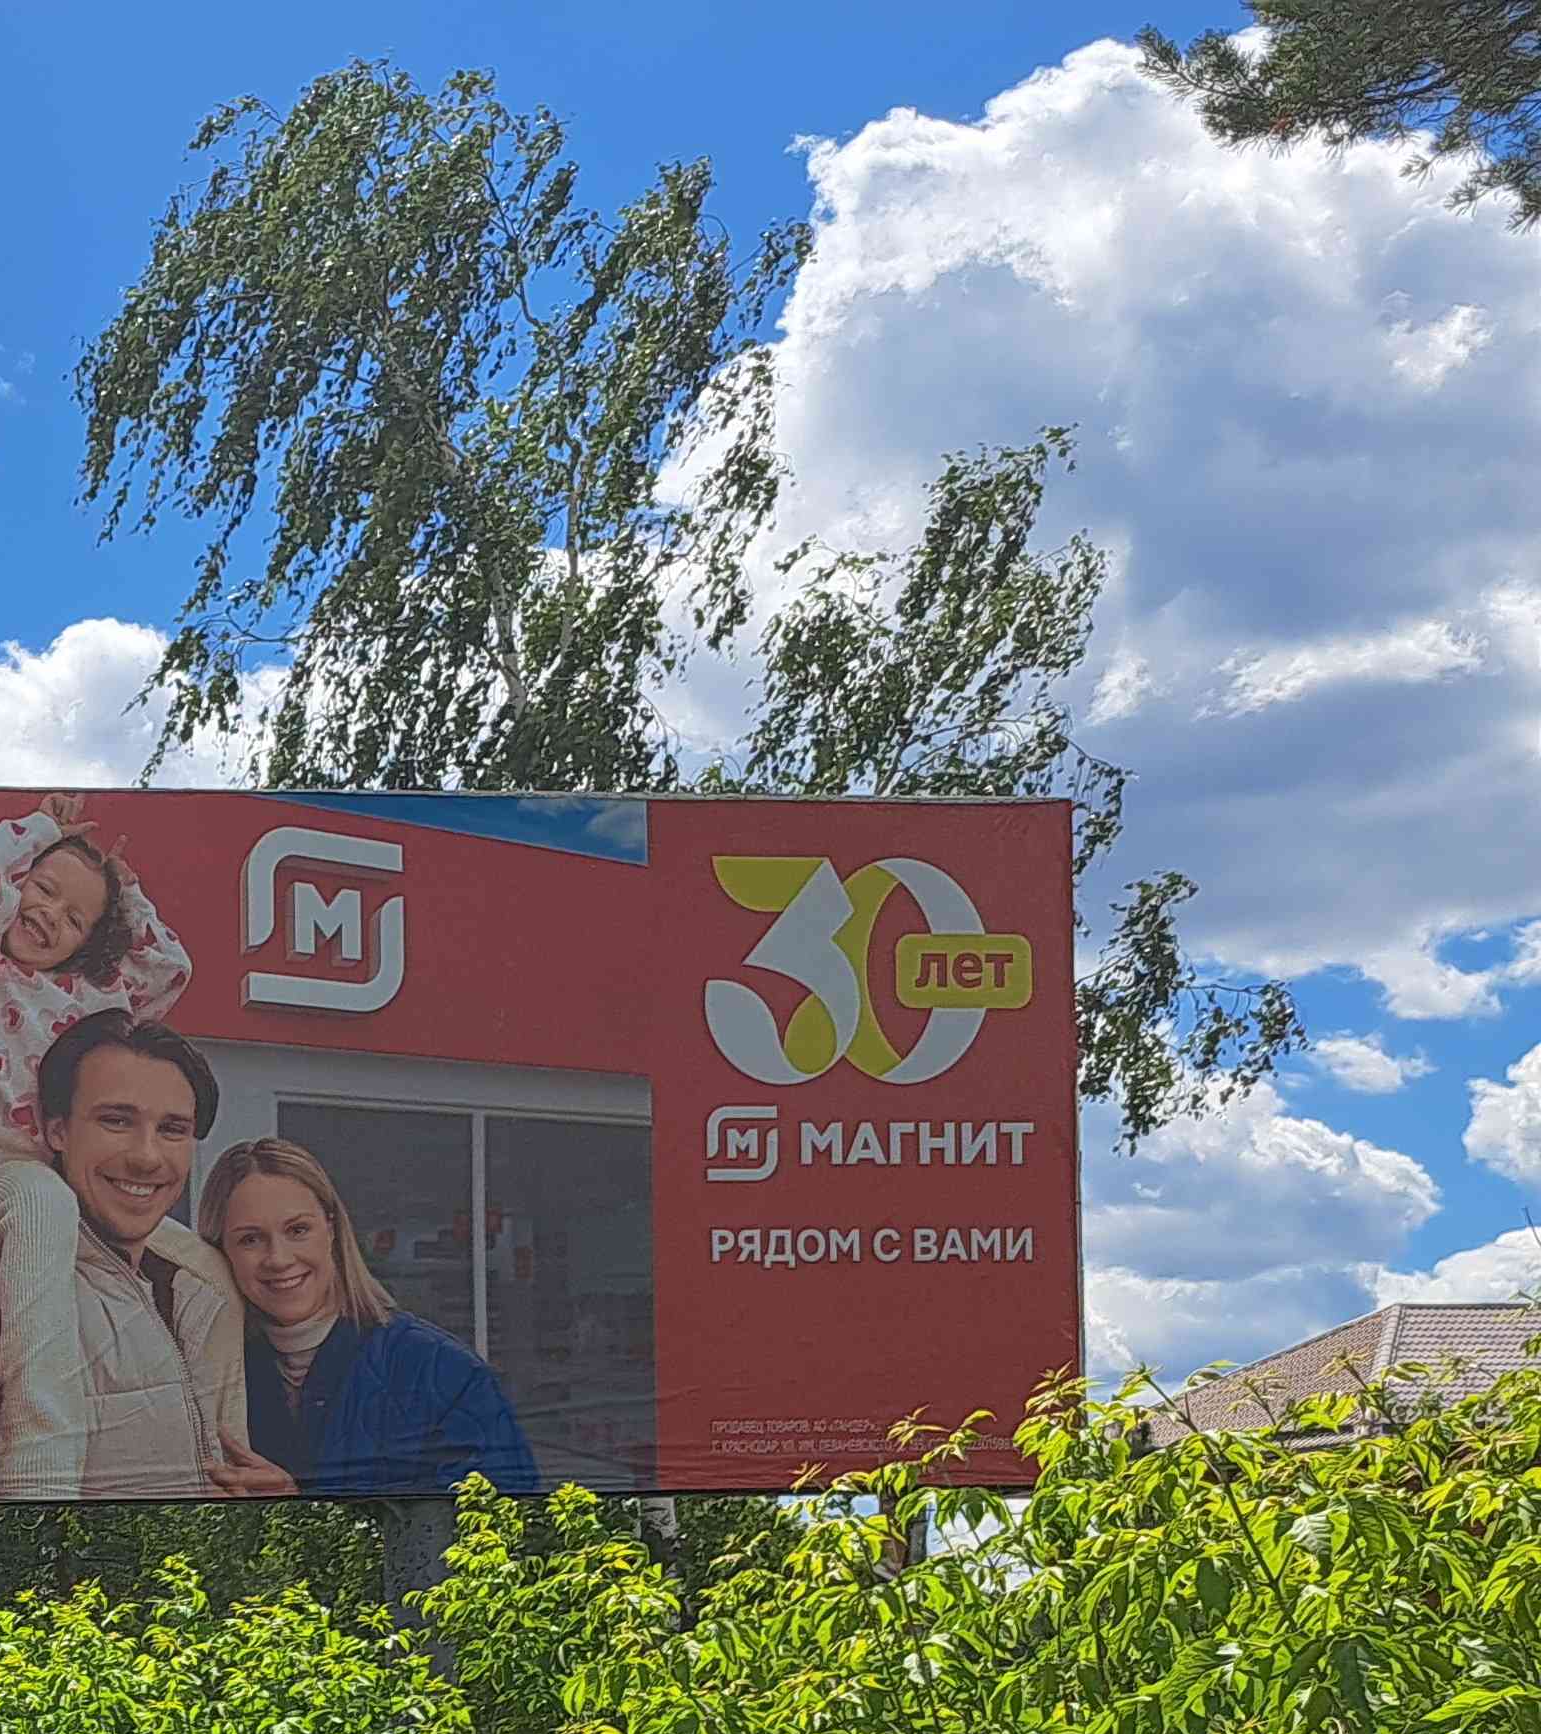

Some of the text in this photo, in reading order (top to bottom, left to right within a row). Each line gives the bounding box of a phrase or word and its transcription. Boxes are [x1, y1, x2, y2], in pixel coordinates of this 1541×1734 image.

[705, 856, 988, 1086] 30
[915, 952, 1015, 989] лет
[800, 1121, 1036, 1166] МАГНИТ
[710, 1226, 1035, 1269] РЯДОМ С ВАМИ
